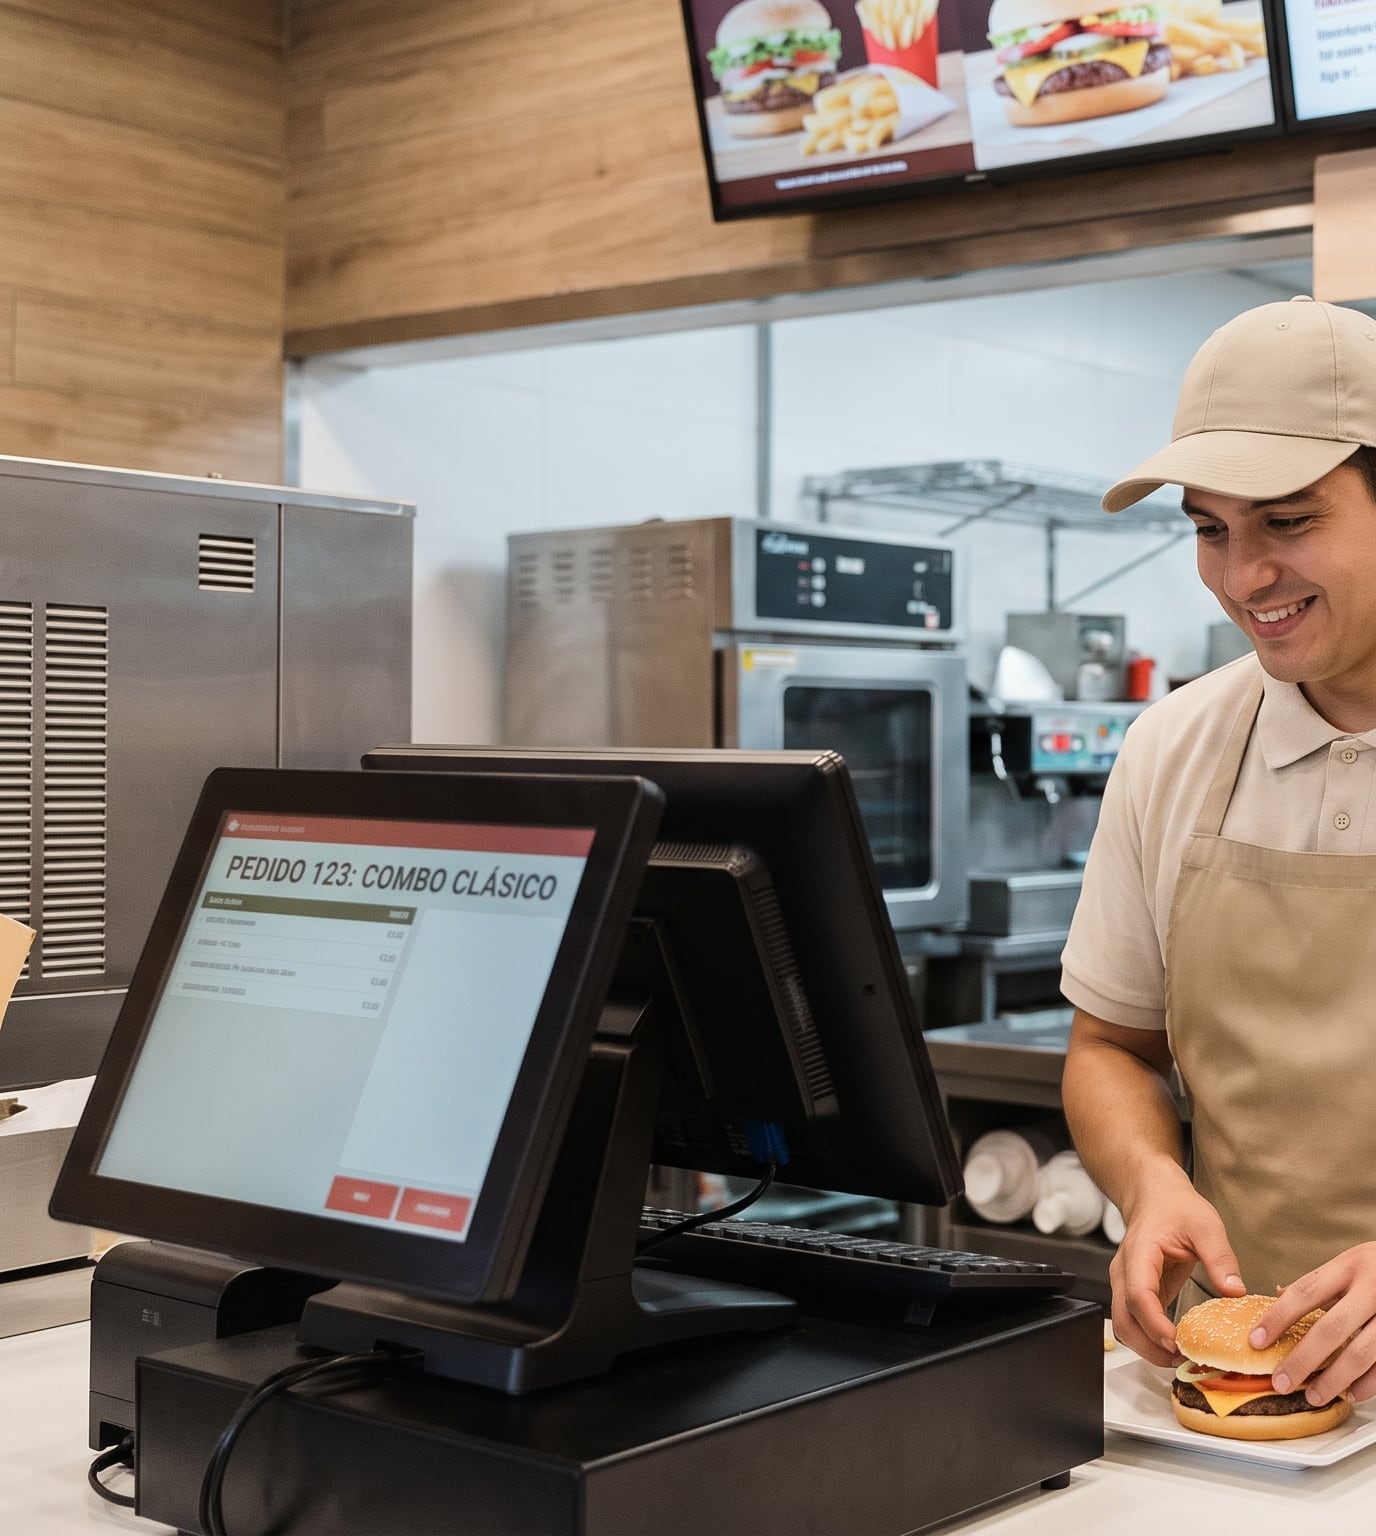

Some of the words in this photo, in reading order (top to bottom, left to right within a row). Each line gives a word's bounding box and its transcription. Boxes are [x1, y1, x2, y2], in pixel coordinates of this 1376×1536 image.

[225, 855, 306, 883] PEDIDO
[312, 861, 357, 887] 123:
[361, 864, 447, 893] COMBO
[452, 866, 558, 901] CLÁSICO
